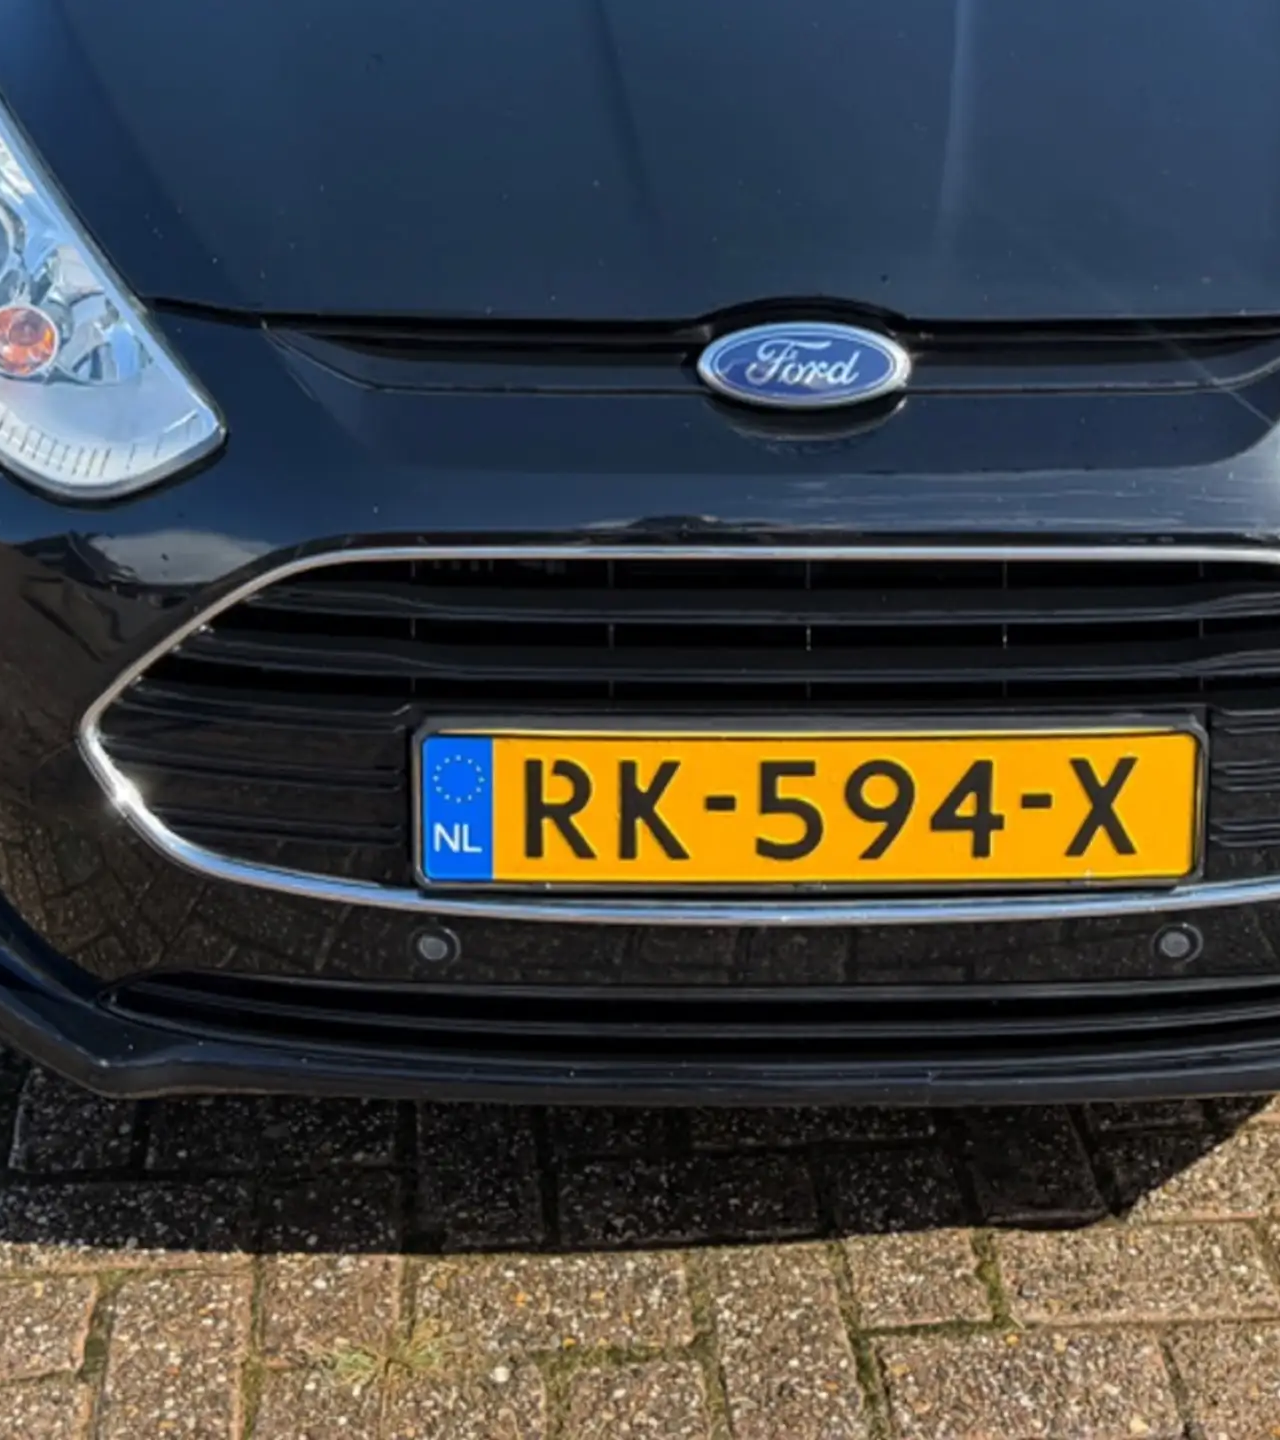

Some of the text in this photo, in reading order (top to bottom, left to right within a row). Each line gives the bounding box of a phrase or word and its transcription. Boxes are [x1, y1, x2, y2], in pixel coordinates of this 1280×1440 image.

[745, 338, 862, 387] Ford
[523, 756, 1140, 861] RK-594-X
[433, 822, 483, 853] NL
